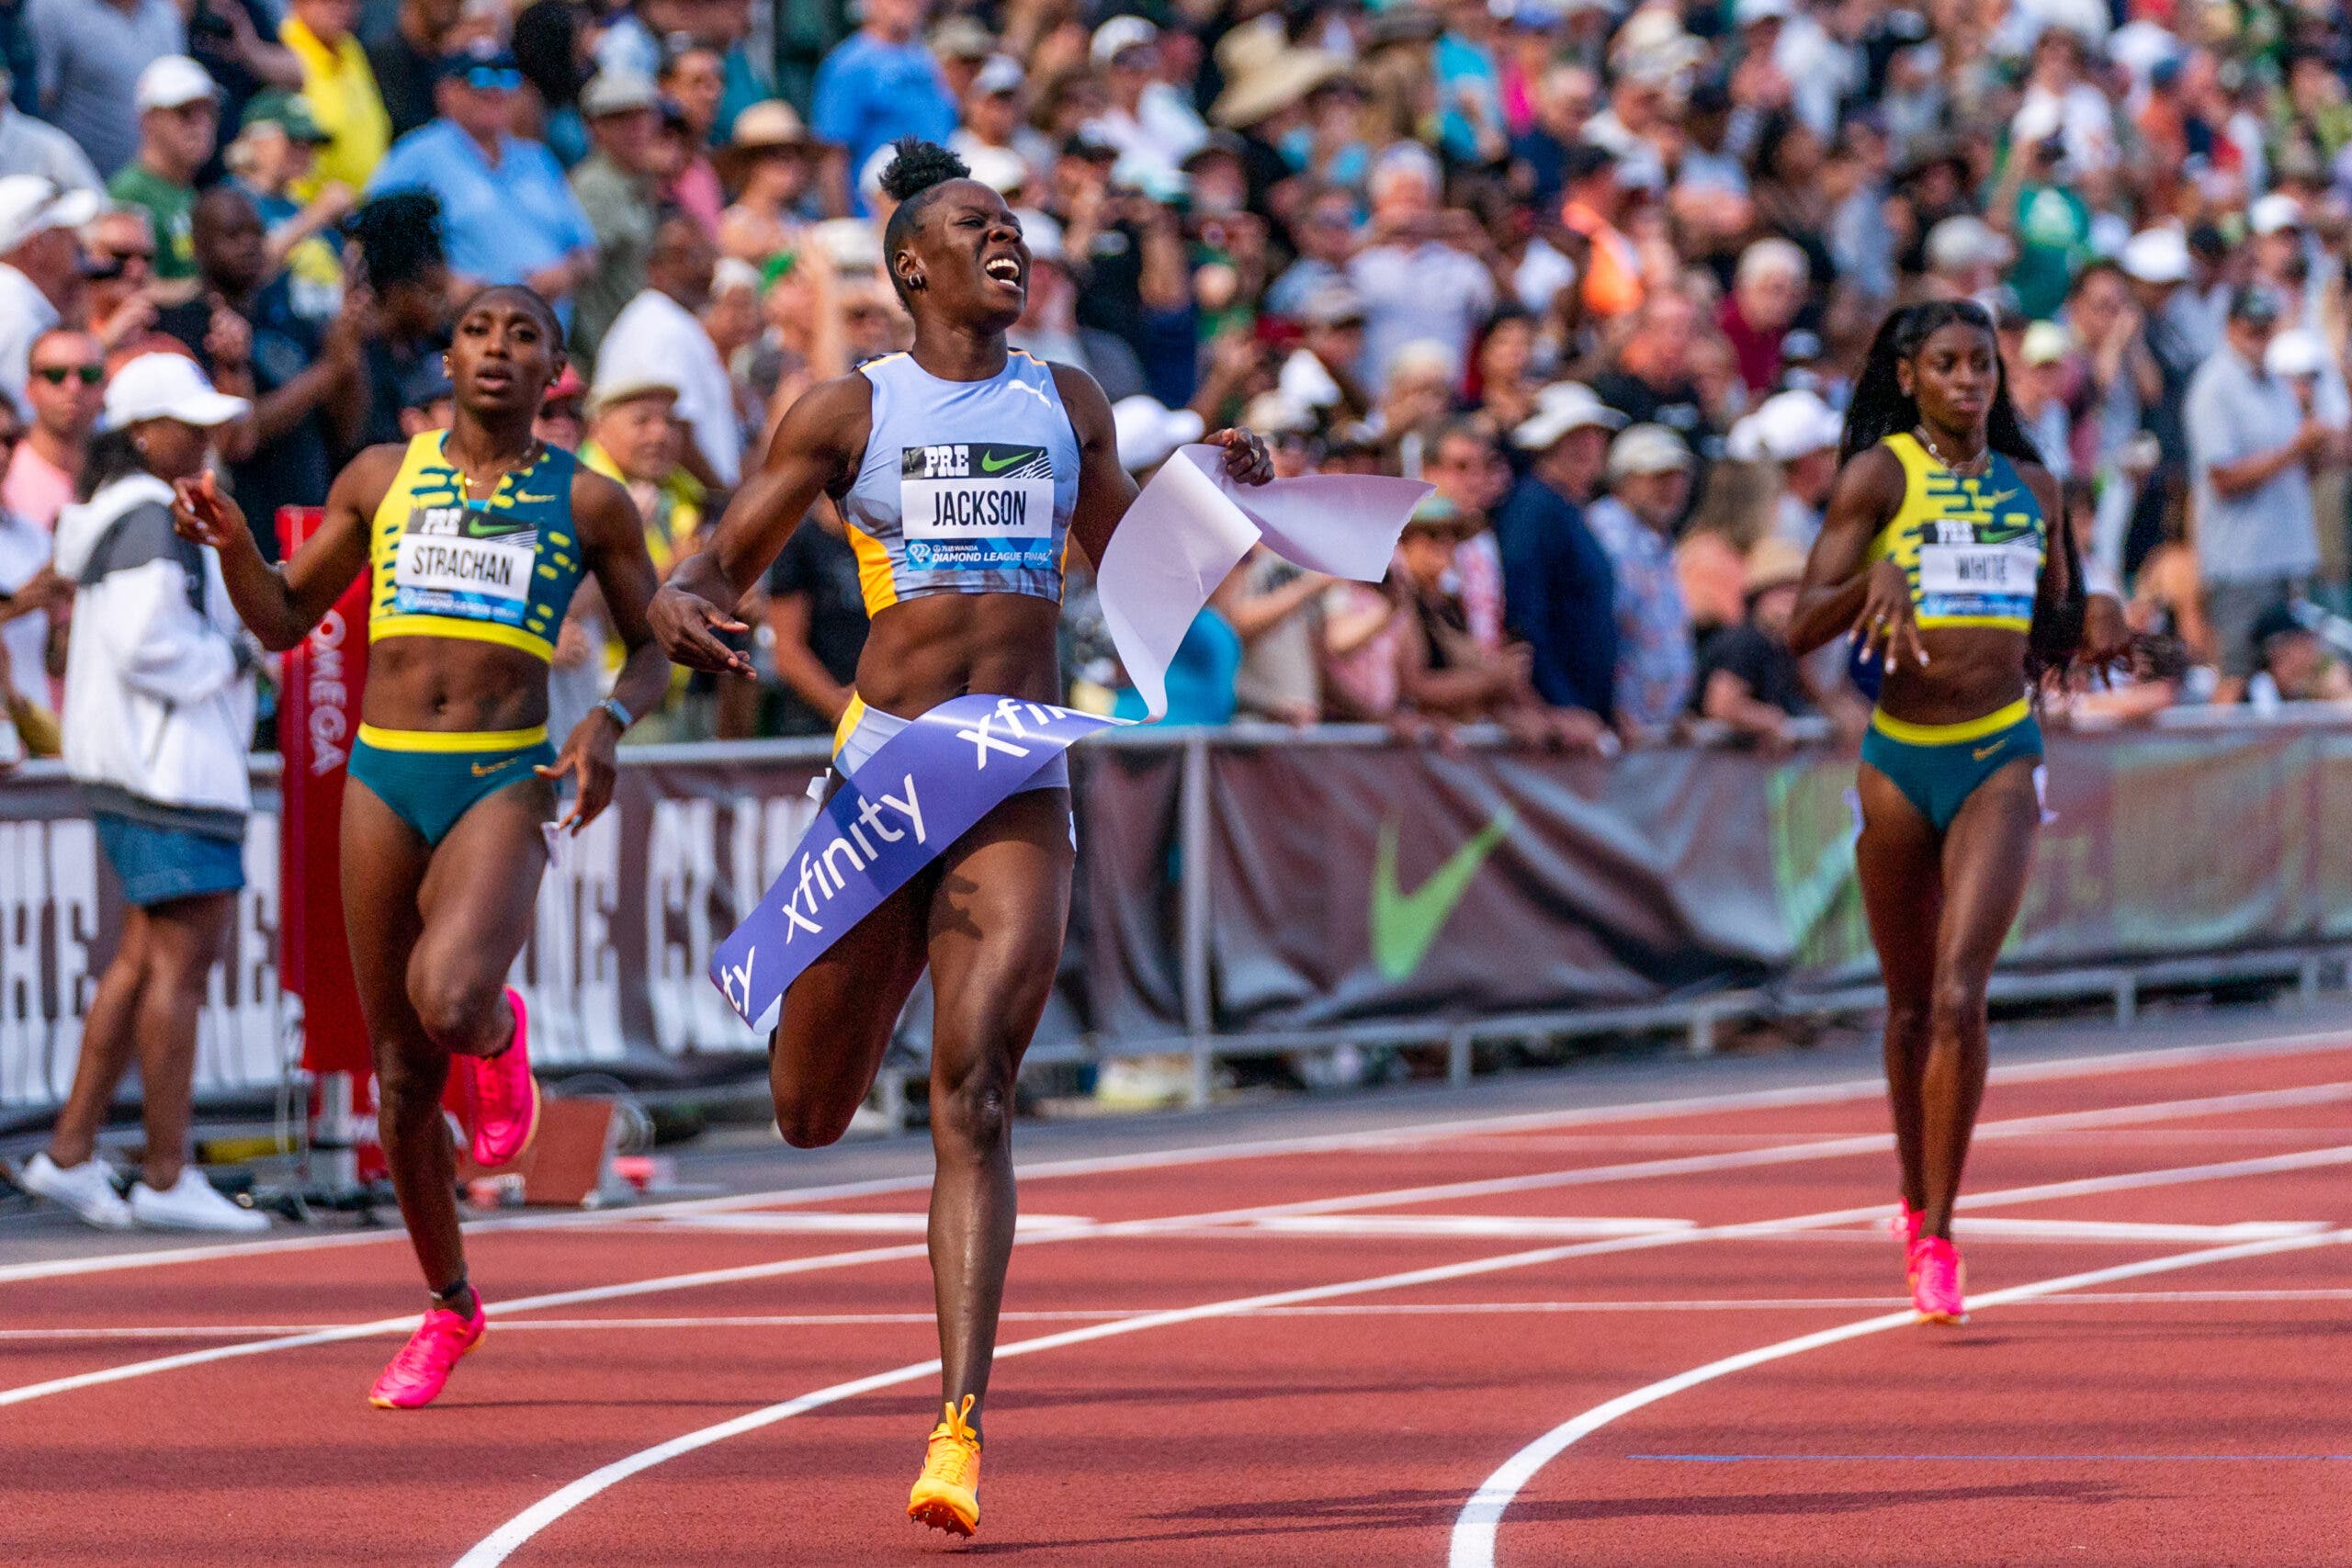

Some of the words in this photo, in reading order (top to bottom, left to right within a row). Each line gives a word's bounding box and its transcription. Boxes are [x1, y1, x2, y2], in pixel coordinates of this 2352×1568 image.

[923, 445, 969, 478] PRE
[933, 490, 1027, 526] JACKSON
[413, 545, 514, 586] STRACHAN
[932, 551, 981, 563] DIAMOND
[984, 551, 1022, 562] LEAGUE
[1957, 556, 2006, 581] WHITE
[310, 608, 347, 777] OMEGA
[782, 773, 926, 944] xfinity
